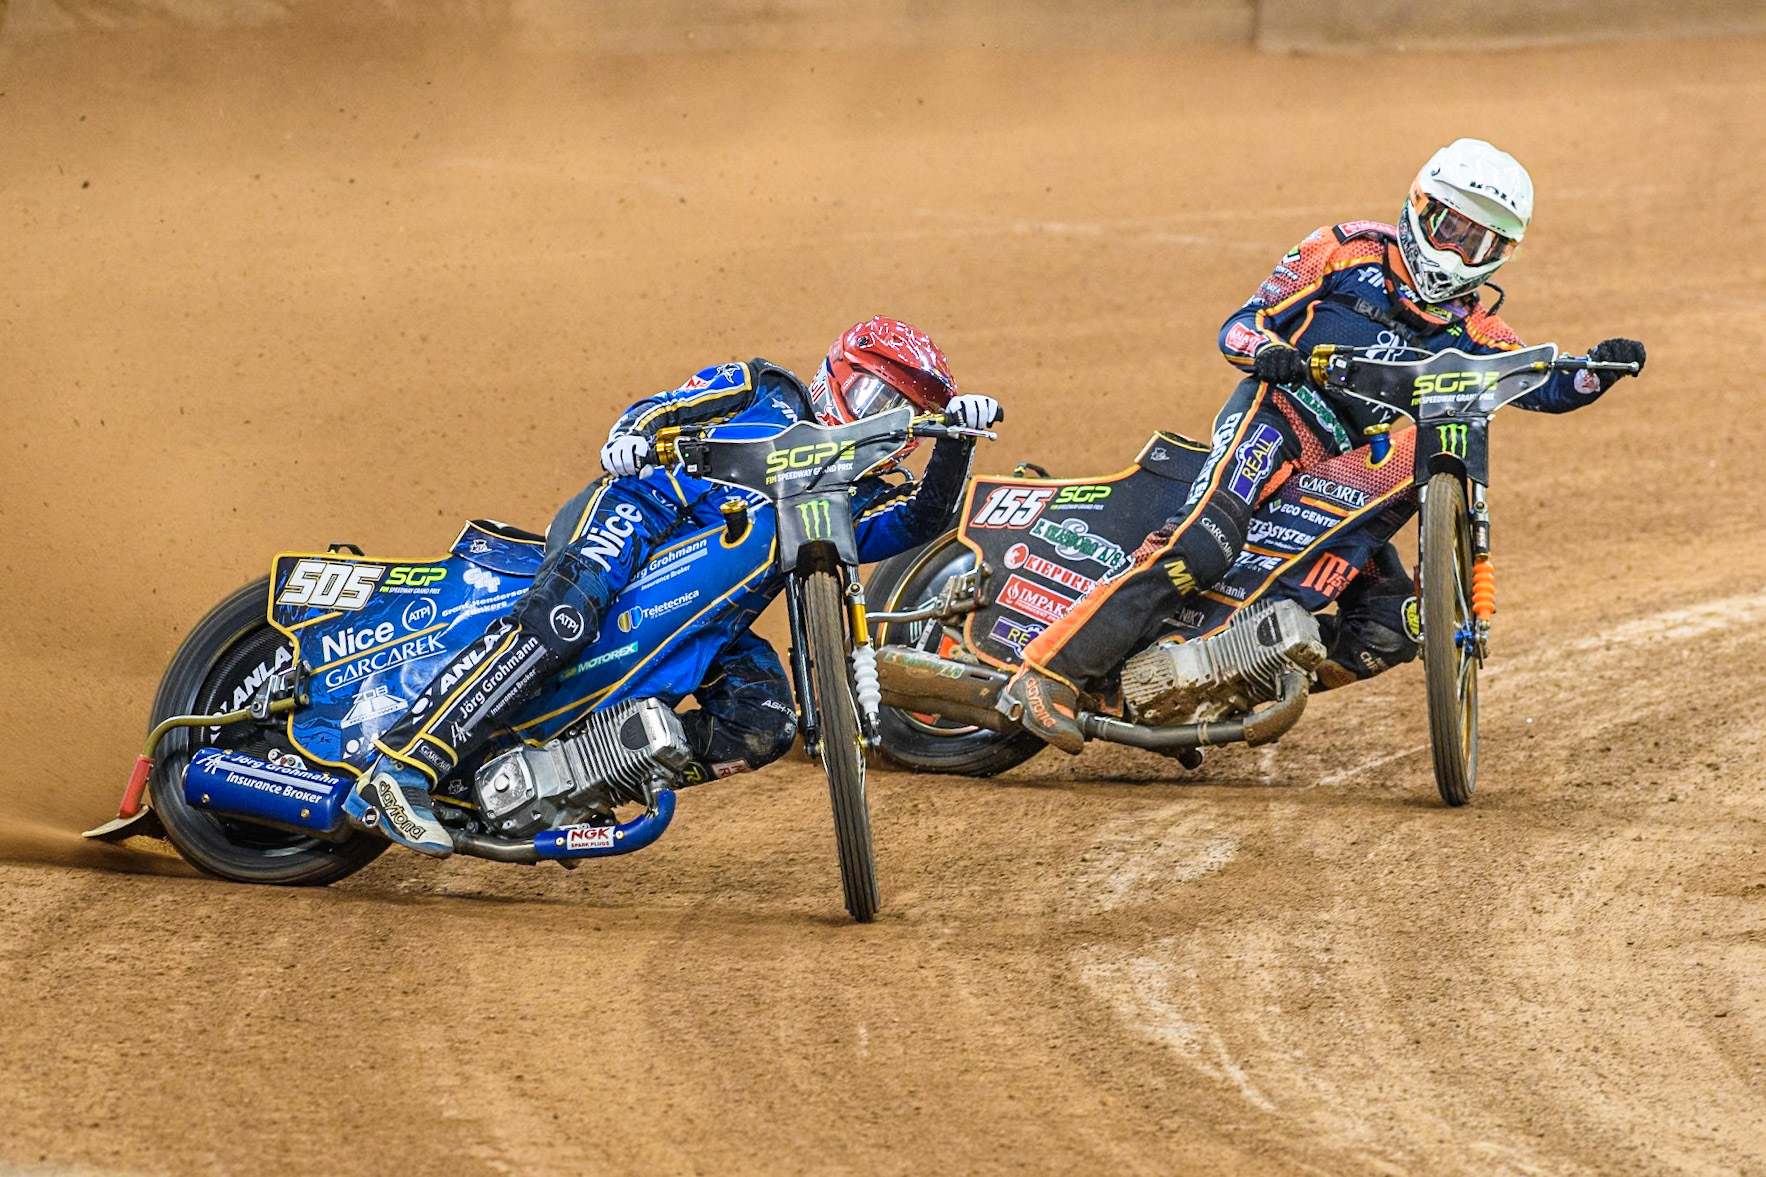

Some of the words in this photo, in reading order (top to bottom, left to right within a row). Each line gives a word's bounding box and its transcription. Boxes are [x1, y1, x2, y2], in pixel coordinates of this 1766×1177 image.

[1420, 394, 1456, 404] SPEEDWAY
[1456, 394, 1477, 402] GRAN
[765, 476, 777, 486] FIM
[777, 468, 813, 482] SPEEDWAY
[837, 463, 854, 472] PRIX
[1241, 437, 1275, 482] REALL
[1055, 485, 1112, 503] SGP
[1299, 474, 1371, 507] GARCAREK
[971, 487, 1056, 528] 155
[1280, 503, 1301, 517] ECO
[580, 502, 643, 573] Nice
[649, 539, 708, 571] Grohmann
[277, 559, 386, 611] 505
[385, 566, 448, 587] SGP
[641, 574, 670, 591] Insurance
[670, 565, 691, 579] Broker
[1025, 556, 1092, 593] KIEPURE
[1211, 581, 1247, 600] ekanik
[408, 605, 431, 623] ATPI
[642, 590, 700, 618] Teletecnica
[1020, 588, 1069, 615] IMPAK
[555, 612, 579, 634] ATPI
[322, 621, 394, 663] Nice
[578, 643, 635, 673] MOTOREX
[325, 632, 447, 689] GARCAREK
[234, 643, 297, 711] ANLA
[460, 691, 486, 719] Jörg
[482, 636, 539, 693] Grohmann
[490, 688, 518, 715] Insurance
[515, 668, 537, 690] Broker
[351, 684, 388, 704] ZDB
[231, 754, 263, 770] Jörg
[265, 762, 339, 786] Grohmann
[226, 771, 282, 795] Insurance
[282, 785, 324, 804] Broker
[379, 780, 426, 840] daytona
[571, 827, 610, 841] NGK
